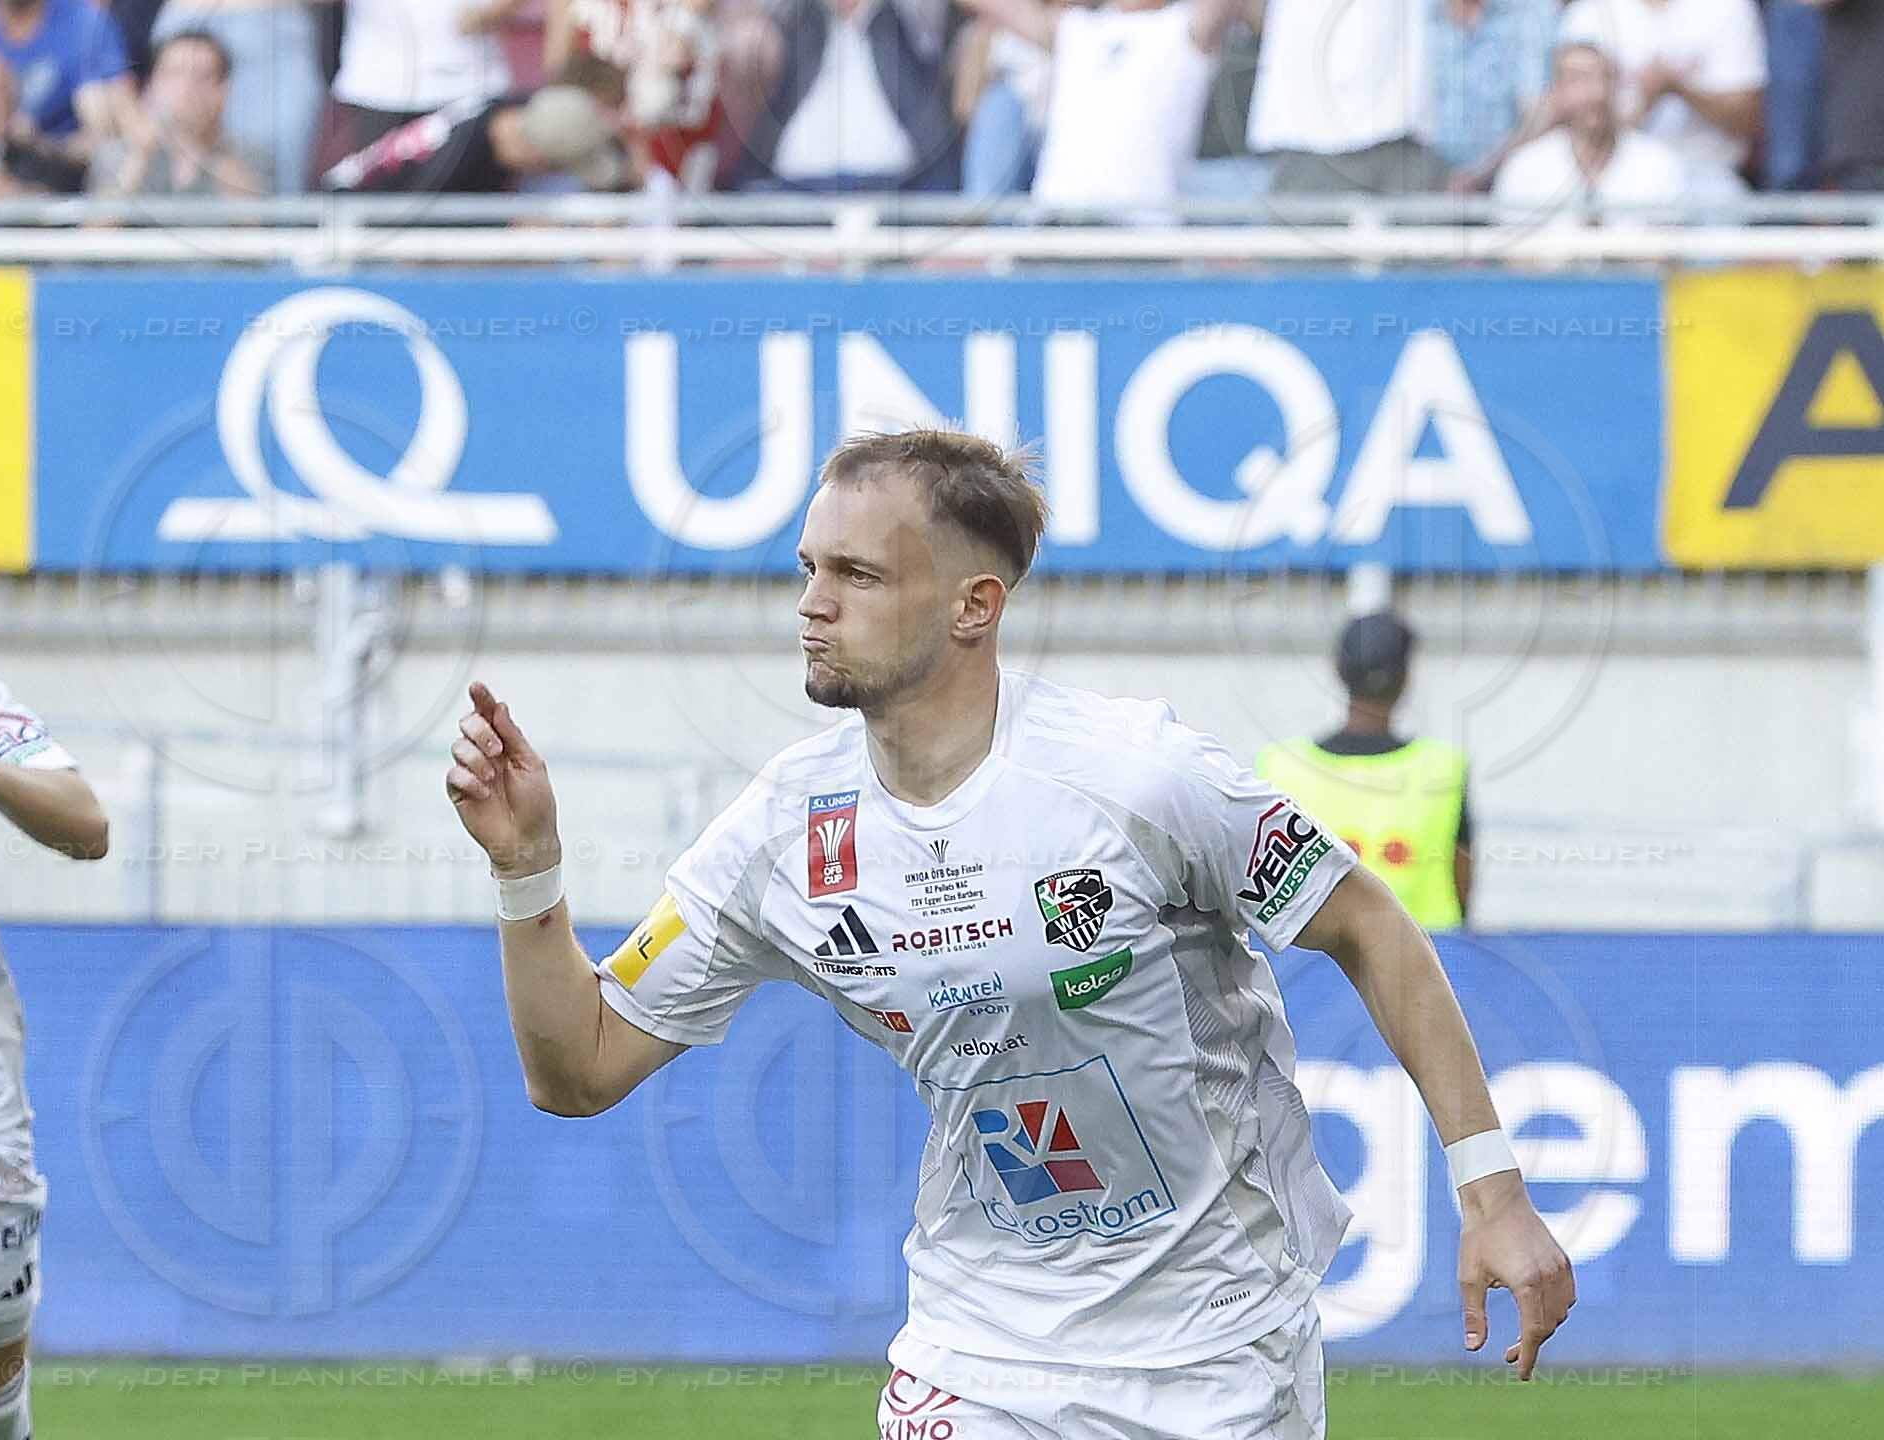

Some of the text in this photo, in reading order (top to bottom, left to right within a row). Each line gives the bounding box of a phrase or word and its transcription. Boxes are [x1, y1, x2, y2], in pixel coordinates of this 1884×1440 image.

[1054, 898, 1105, 934] WAC
[891, 917, 1014, 953] ROBITSCH
[968, 1004, 1011, 1016] SPORT
[951, 1032, 1028, 1058] velox.at
